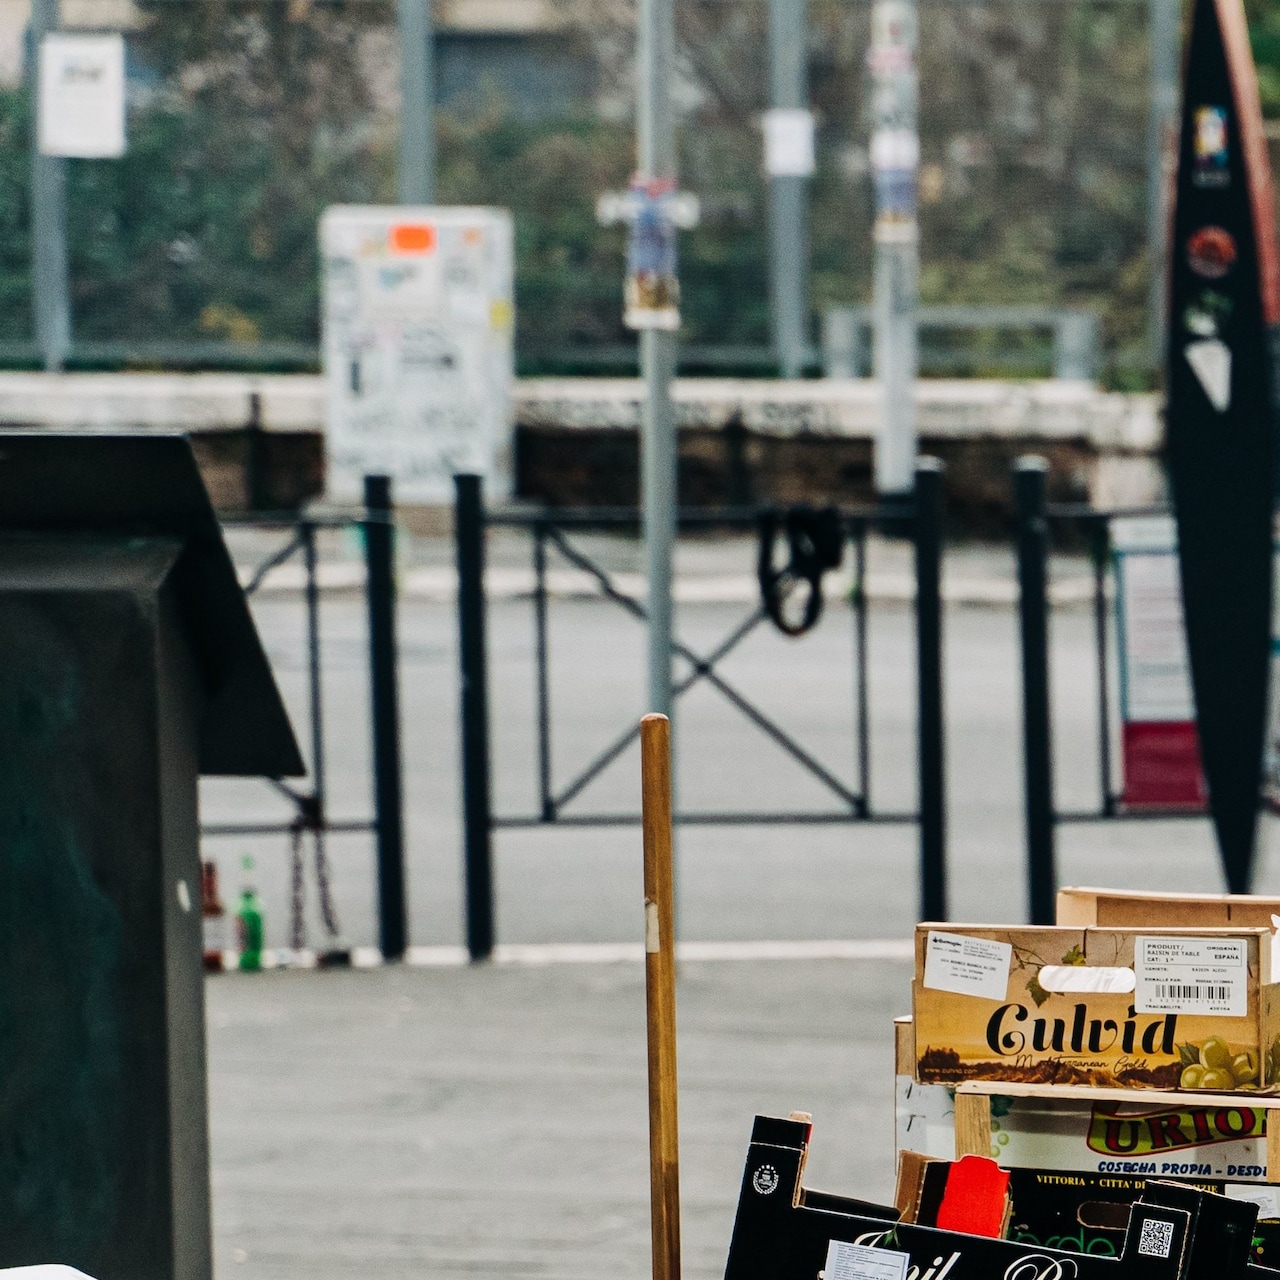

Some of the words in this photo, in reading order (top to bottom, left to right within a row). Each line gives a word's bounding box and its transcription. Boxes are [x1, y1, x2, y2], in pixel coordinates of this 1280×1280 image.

[986, 1003, 1178, 1056] Culvid
[1103, 1106, 1267, 1152] URIO
[1036, 1174, 1085, 1186] VITTORIA
[1099, 1179, 1133, 1188] CITTA'
[1098, 1161, 1155, 1174] COSECHA
[1161, 1163, 1212, 1175] PROPIA
